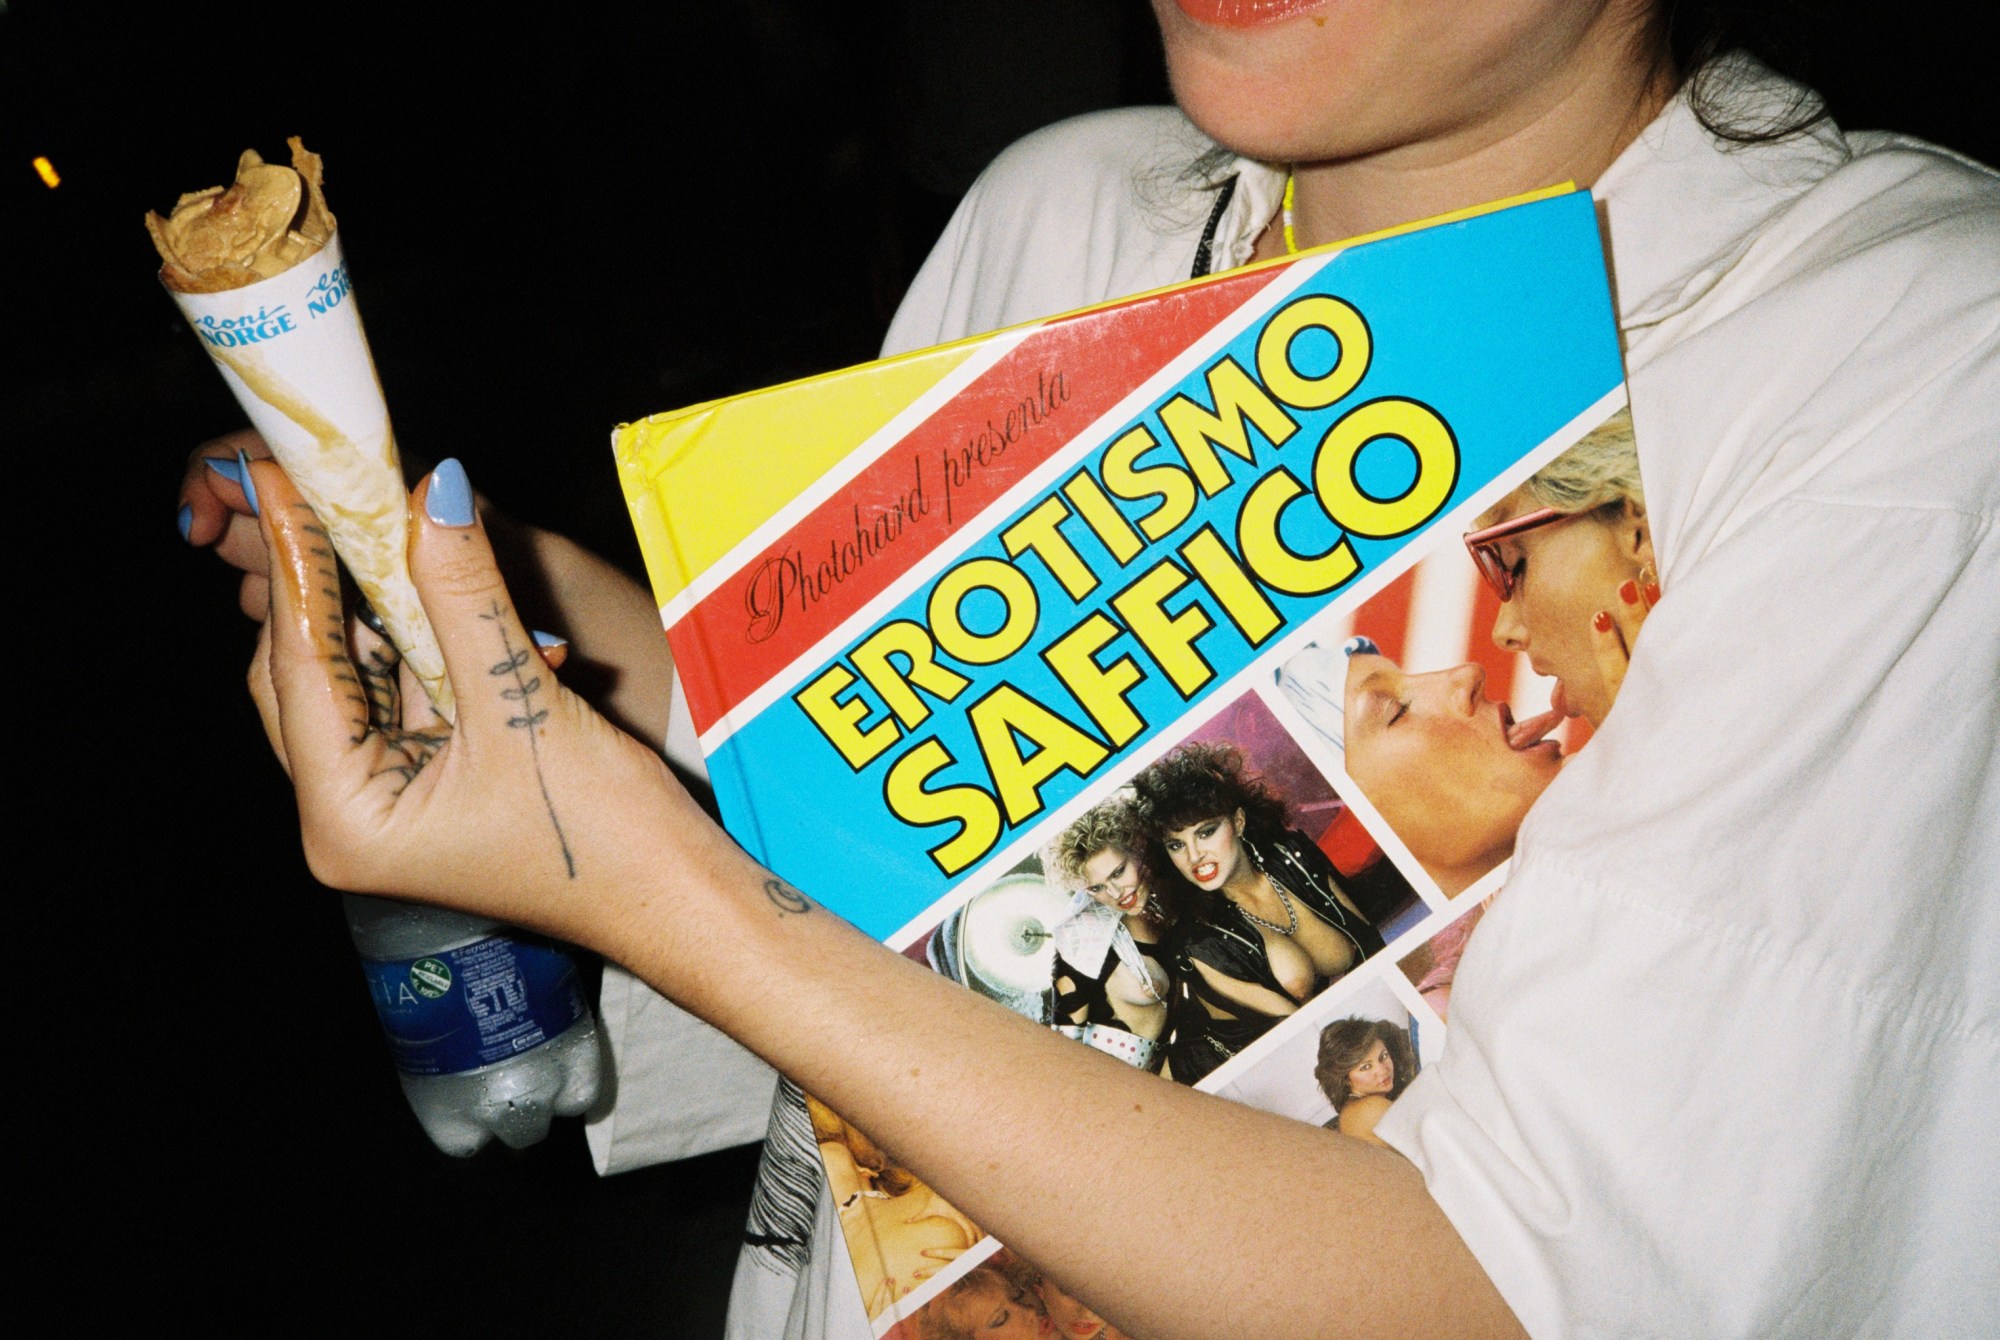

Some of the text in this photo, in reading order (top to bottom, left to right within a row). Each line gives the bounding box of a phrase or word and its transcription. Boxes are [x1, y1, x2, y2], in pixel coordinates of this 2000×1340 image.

[200, 312, 297, 348] NORGE
[744, 370, 1071, 645] Photohard presenta
[796, 293, 1374, 774] EROTISMO
[882, 395, 1462, 879] SAFFICO
[424, 961, 444, 975] PET
